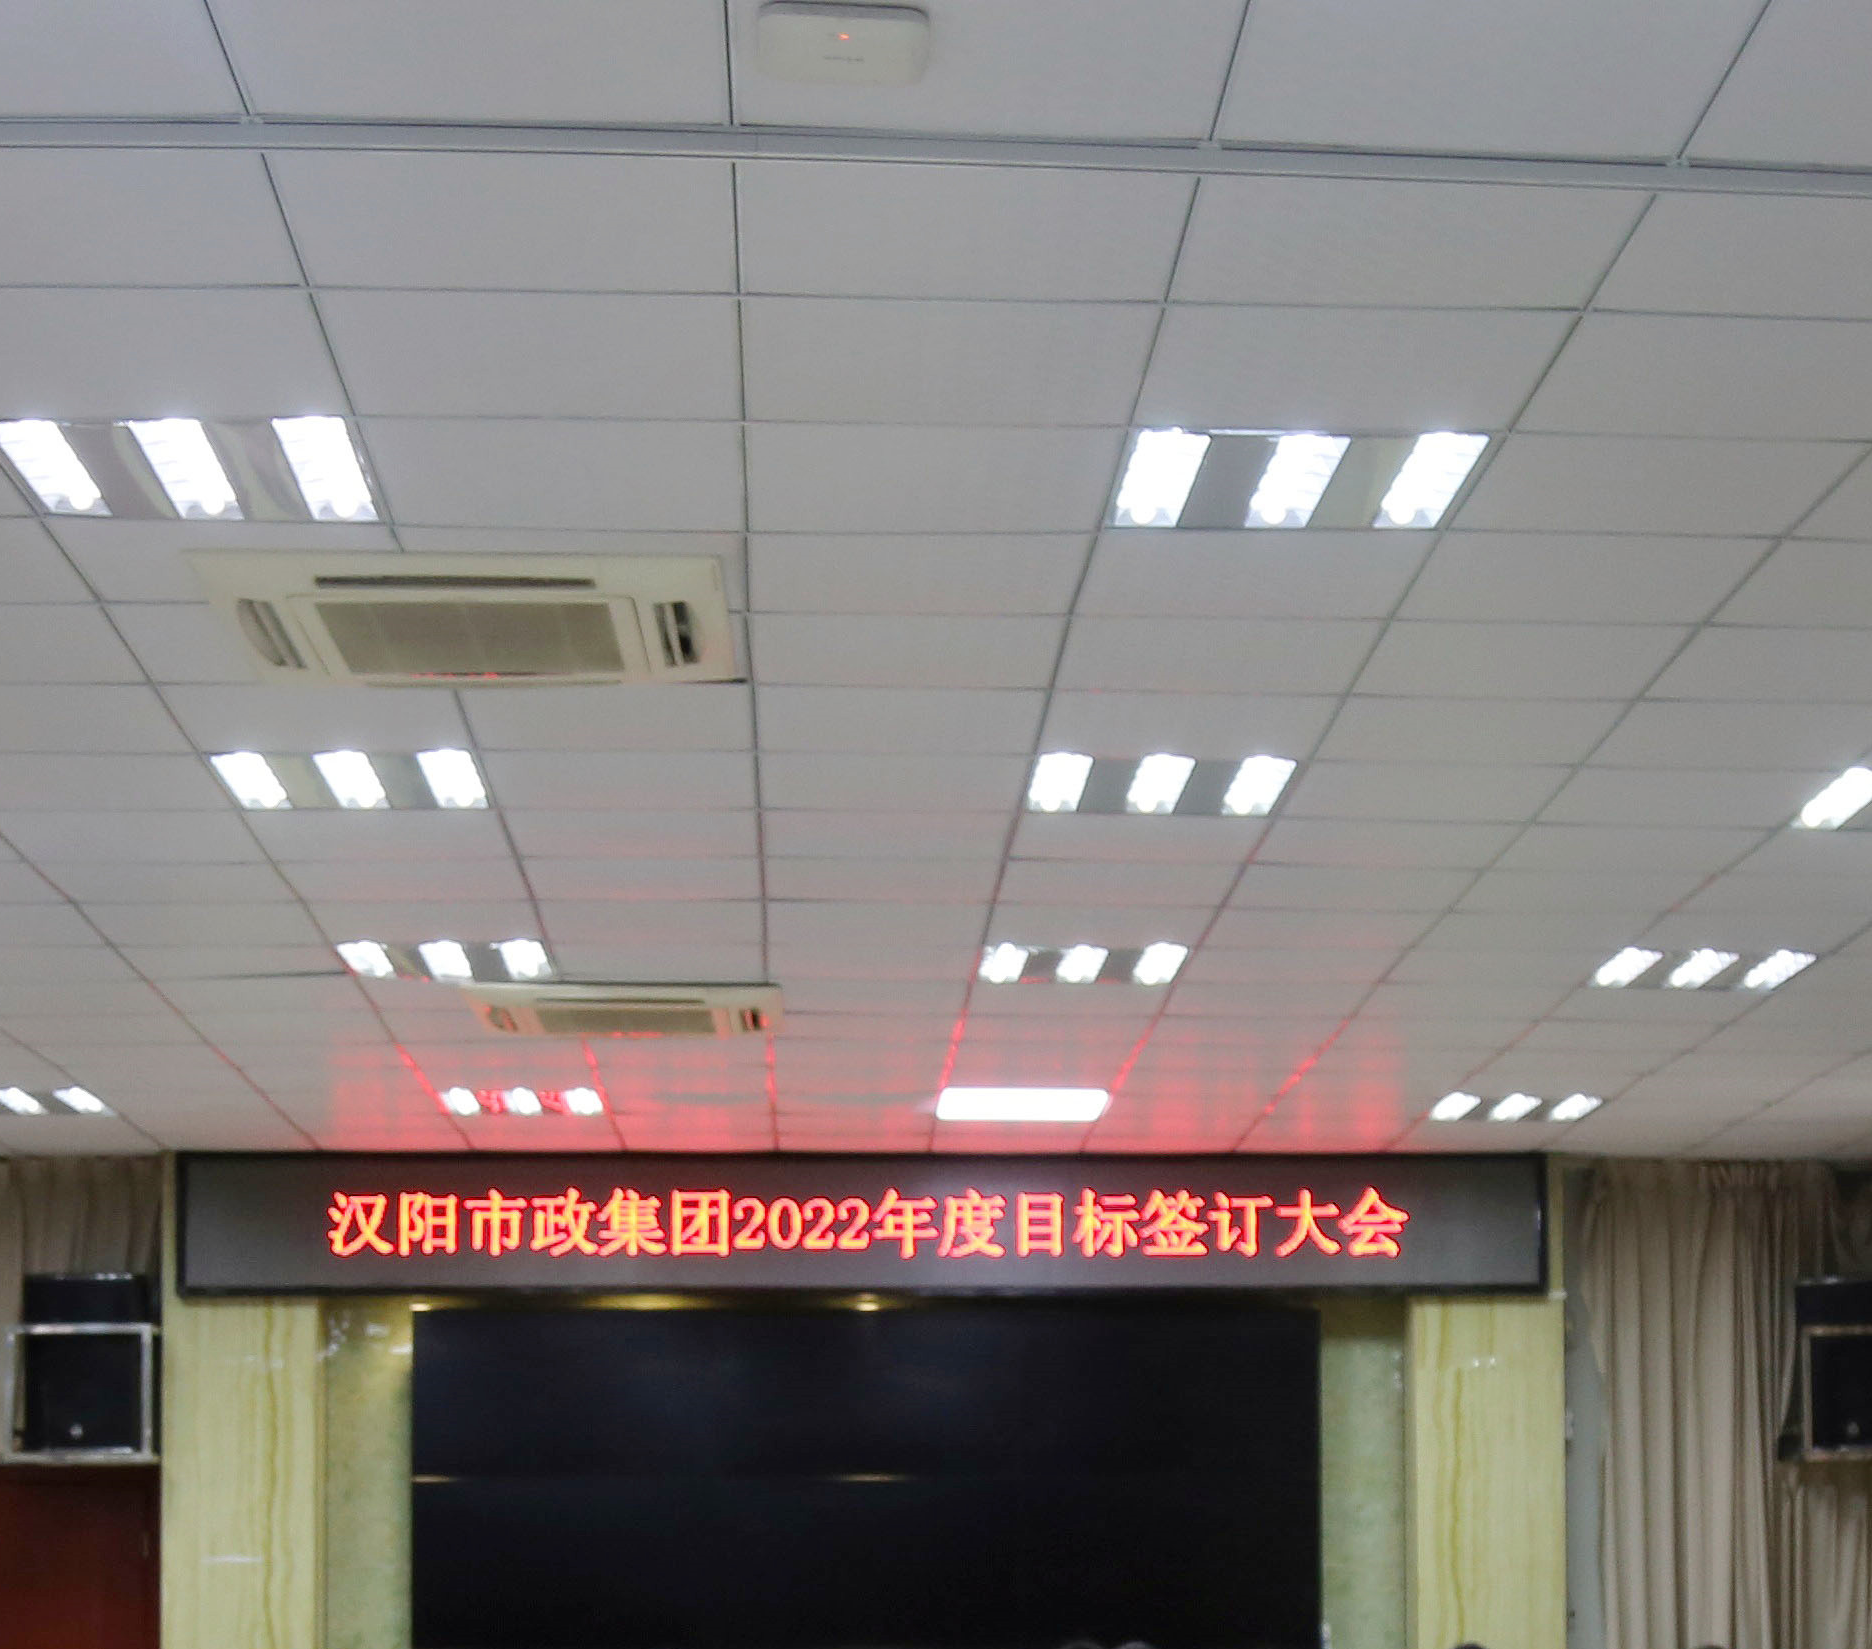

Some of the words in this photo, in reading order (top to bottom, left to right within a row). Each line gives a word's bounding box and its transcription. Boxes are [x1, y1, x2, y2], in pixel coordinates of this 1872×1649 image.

[327, 1187, 1410, 1258] 汉阳市政集团2022年度目标签订大会
